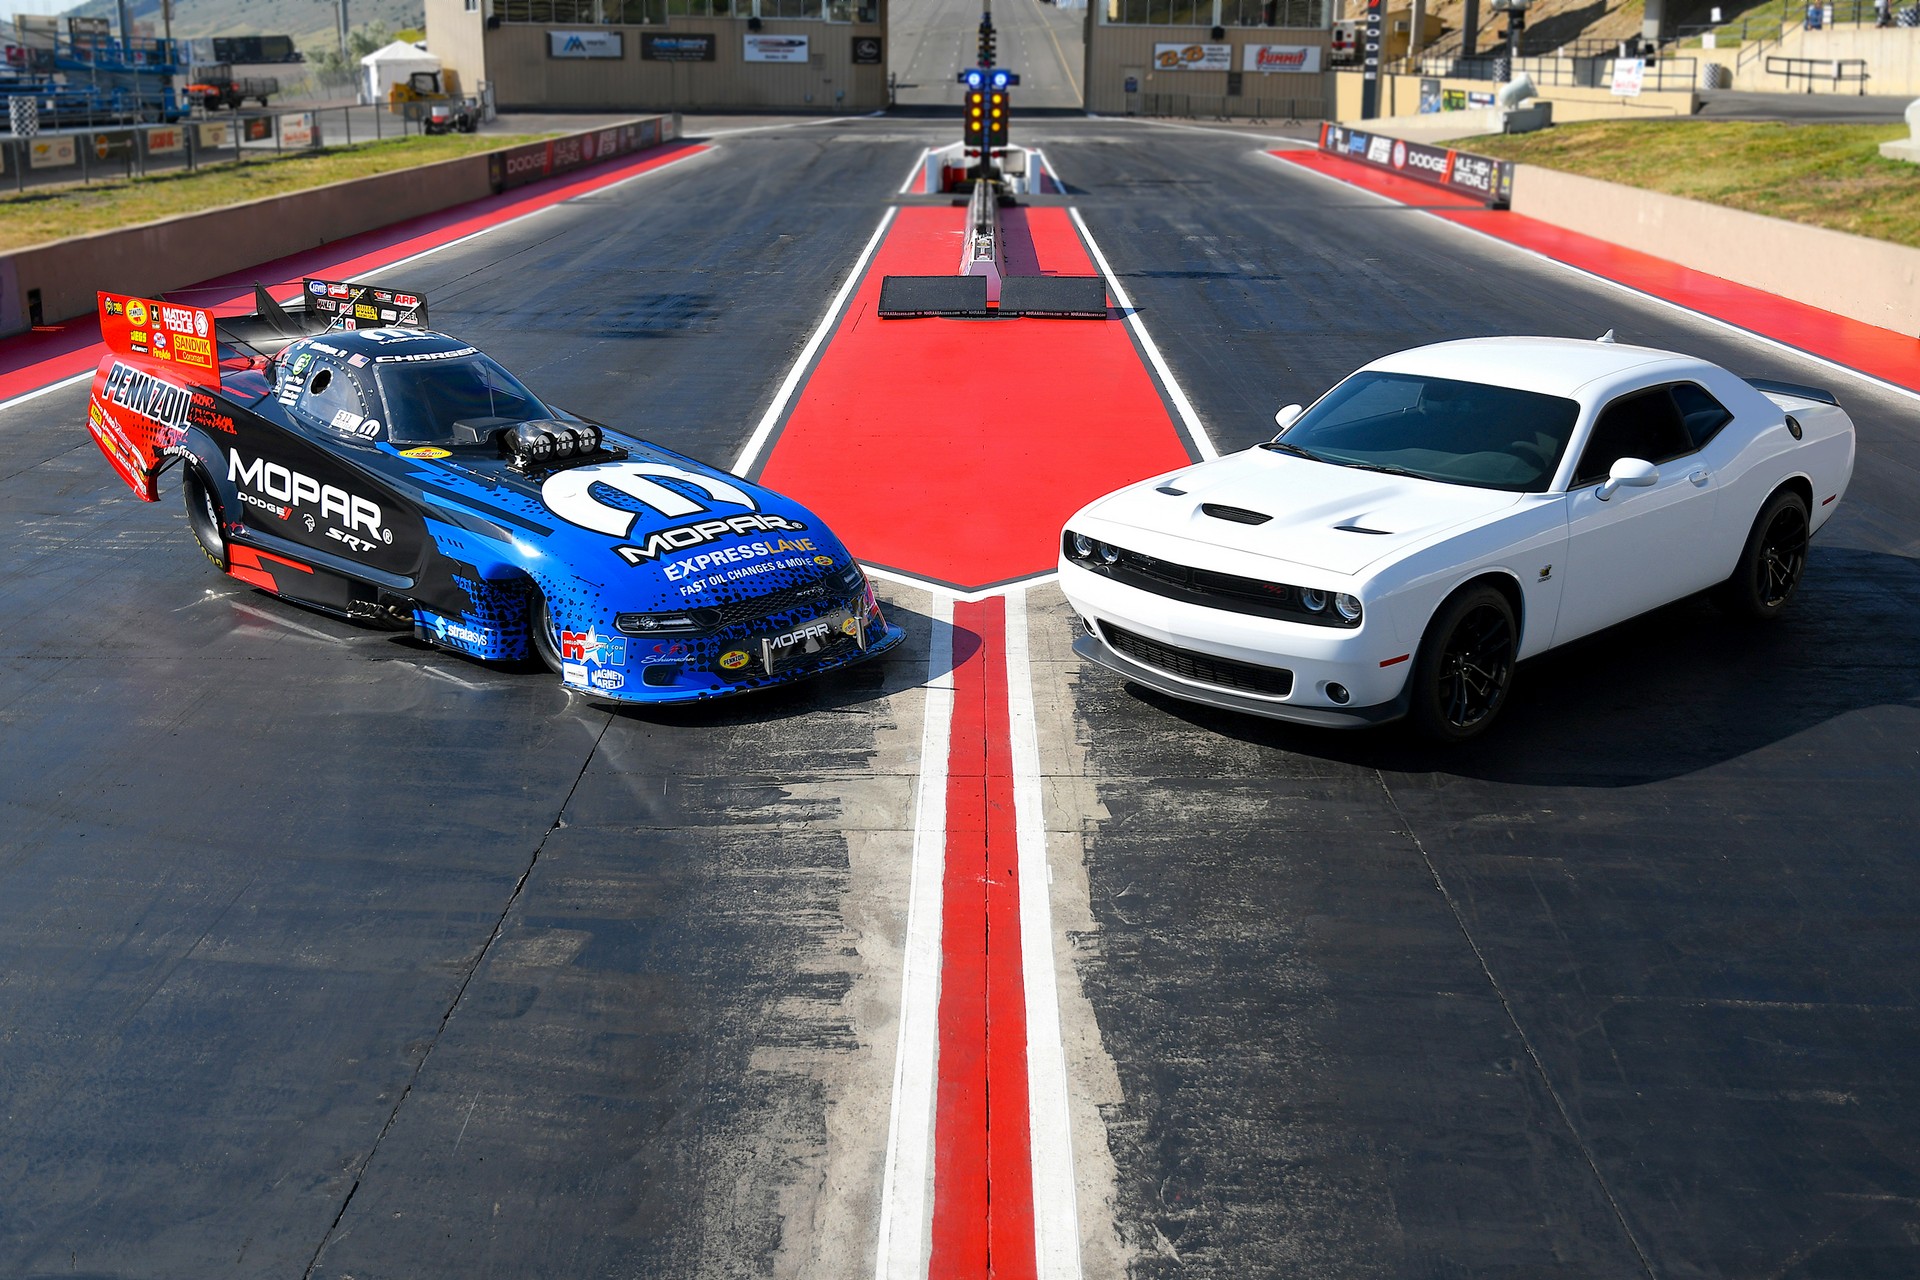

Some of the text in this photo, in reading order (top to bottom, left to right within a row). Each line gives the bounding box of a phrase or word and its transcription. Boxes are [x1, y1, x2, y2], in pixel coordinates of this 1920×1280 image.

[1408, 152, 1448, 174] DODGE
[395, 295, 416, 305] ARP
[163, 307, 192, 321] MATCO
[165, 318, 193, 334] TOOLS
[175, 336, 209, 354] SANDVIK
[375, 347, 478, 362] CHARGER
[182, 352, 204, 363] Coromant
[102, 361, 192, 433] PENNZOIL
[163, 445, 198, 465] GOODYEAR
[227, 447, 382, 541] MOPAR
[237, 491, 286, 517] DODGE
[325, 527, 377, 552] SRT
[680, 579, 707, 597] FAST
[709, 573, 727, 587] OIL
[729, 561, 776, 581] CHANGES
[776, 561, 786, 570] &
[447, 622, 487, 646] stratasys
